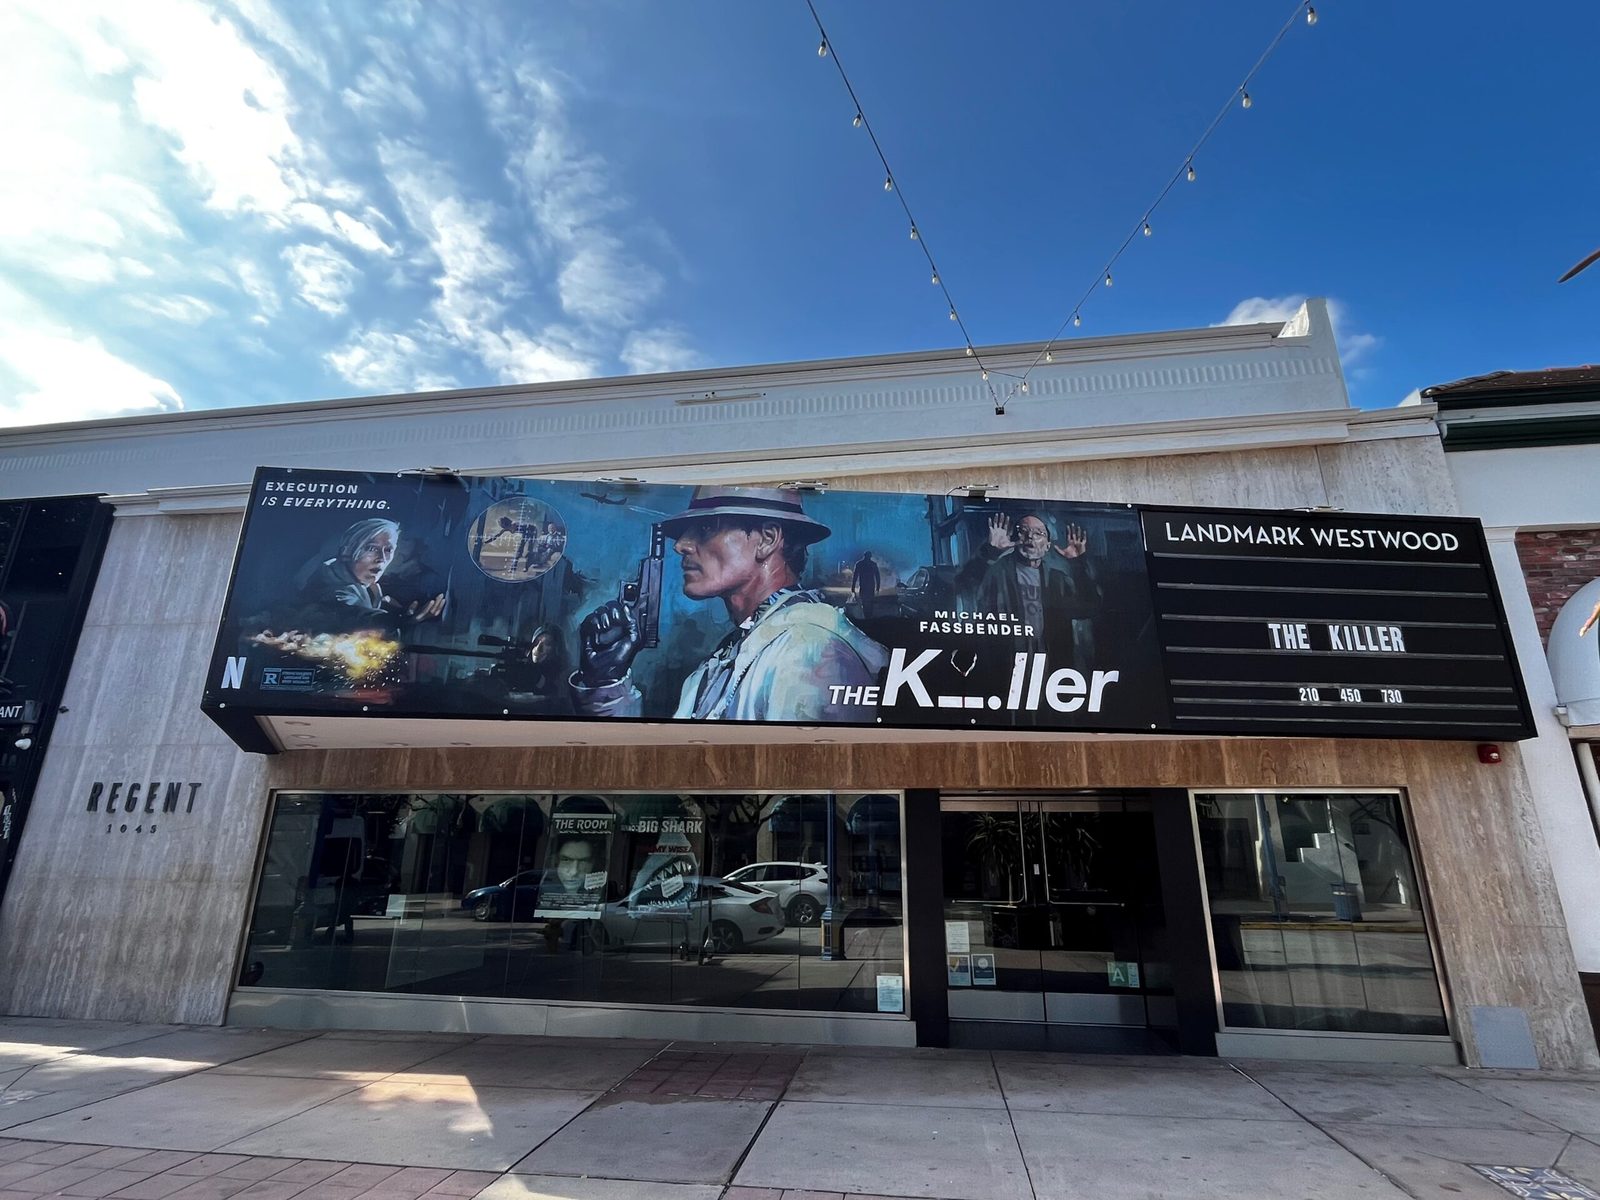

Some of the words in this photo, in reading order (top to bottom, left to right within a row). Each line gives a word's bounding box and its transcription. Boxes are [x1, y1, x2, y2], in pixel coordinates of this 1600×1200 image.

[265, 481, 358, 494] EXECUTION
[261, 496, 278, 506] IS
[283, 497, 391, 510] EVERYTHING.
[1165, 521, 1304, 546] LANDMARK
[1310, 527, 1459, 551] WESTWOOD
[934, 610, 1019, 622] MICHAEL
[919, 621, 1035, 637] FASSBENDER
[1268, 623, 1311, 650] THE
[1328, 624, 1406, 652] KILLER
[221, 656, 246, 689] N
[263, 672, 278, 685] R
[828, 685, 881, 706] THE
[1299, 687, 1320, 702] 210
[1340, 687, 1362, 703] 450
[1381, 688, 1402, 704] 730
[86, 781, 202, 814] REGENT
[106, 823, 157, 834] 1045
[555, 818, 574, 830] THE
[576, 818, 609, 830] ROOM
[638, 820, 659, 834] BIG
[661, 820, 704, 834] SHARK
[1112, 967, 1125, 982] A
